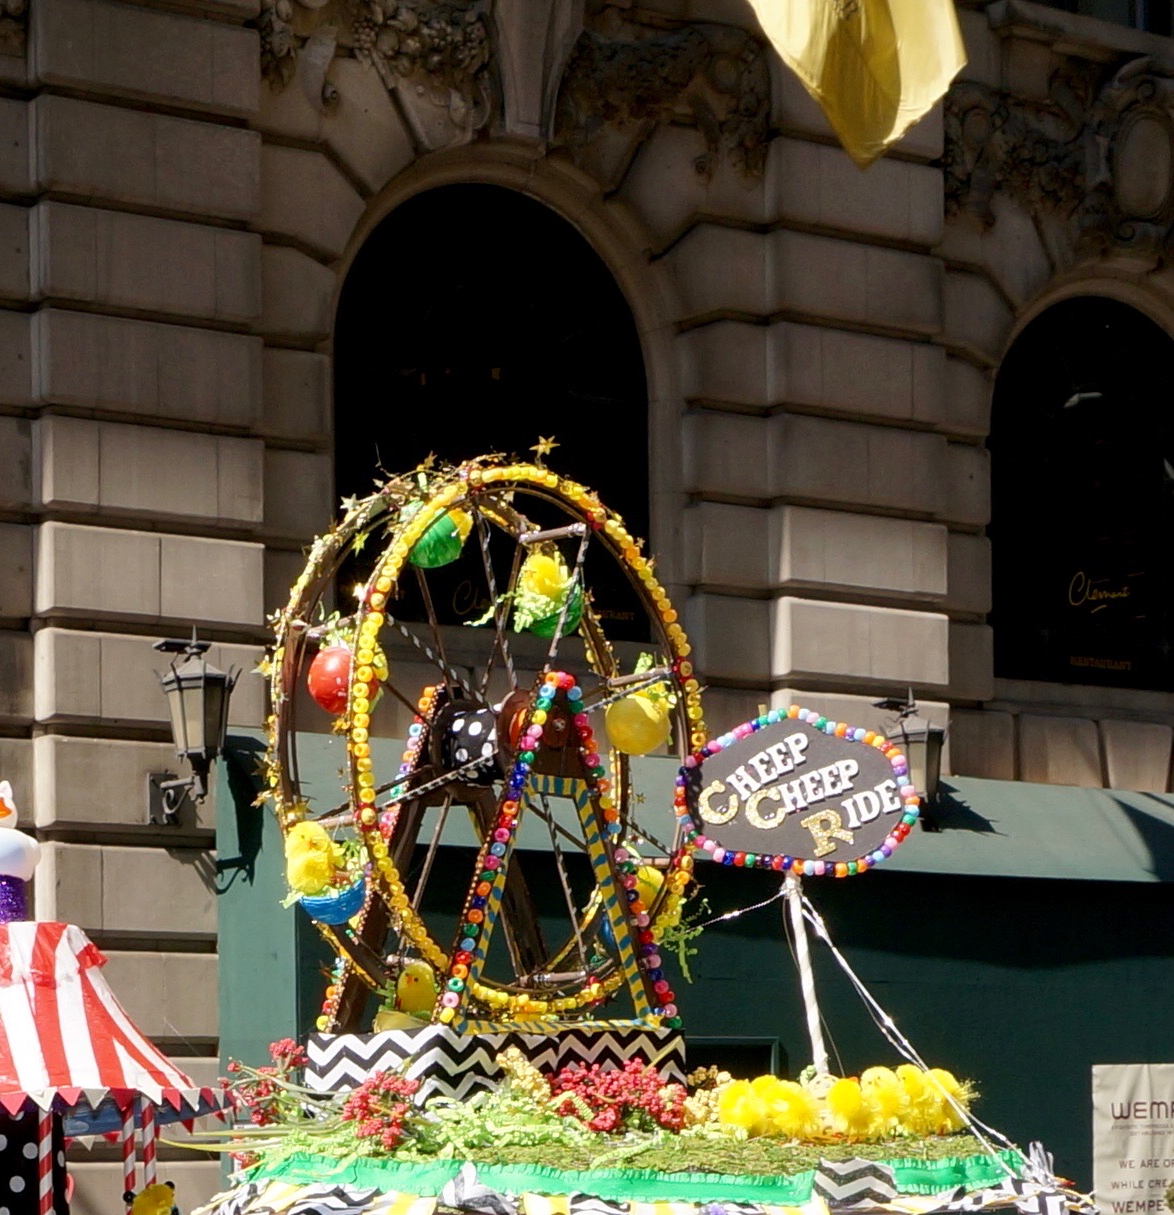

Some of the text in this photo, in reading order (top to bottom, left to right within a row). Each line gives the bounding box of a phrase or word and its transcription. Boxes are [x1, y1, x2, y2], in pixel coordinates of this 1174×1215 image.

[698, 732, 809, 825] CHEEP
[745, 759, 859, 830] CHEEP
[800, 779, 902, 857] RIDE
[1111, 1101, 1174, 1120] WEM
[1119, 1160, 1135, 1169] WE
[1140, 1158, 1161, 1169] ARE
[1111, 1180, 1145, 1190] WHILE
[1112, 1200, 1165, 1214] WEMPE
